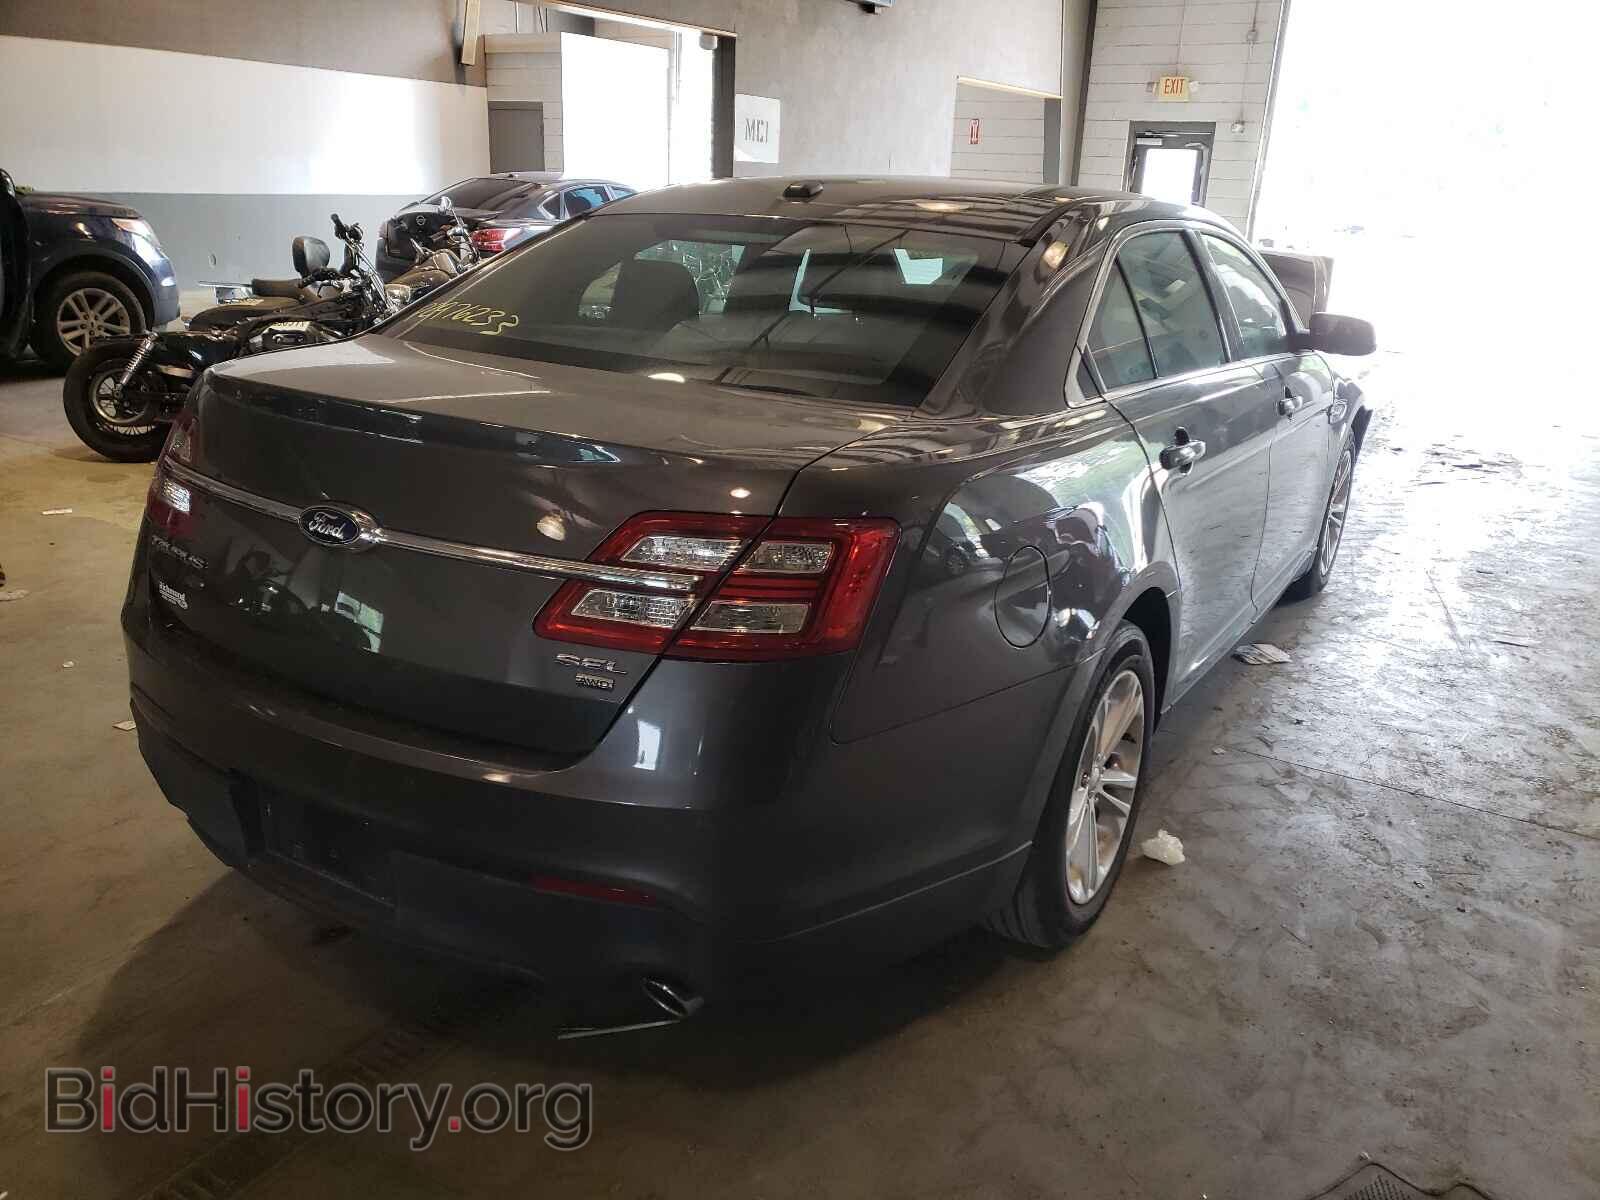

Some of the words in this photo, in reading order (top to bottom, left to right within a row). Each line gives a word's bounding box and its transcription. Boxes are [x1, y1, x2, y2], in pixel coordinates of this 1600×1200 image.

[1164, 78, 1185, 94] EXIT
[308, 511, 347, 540] Ford
[554, 653, 627, 674] SEL
[575, 675, 613, 689] AWD
